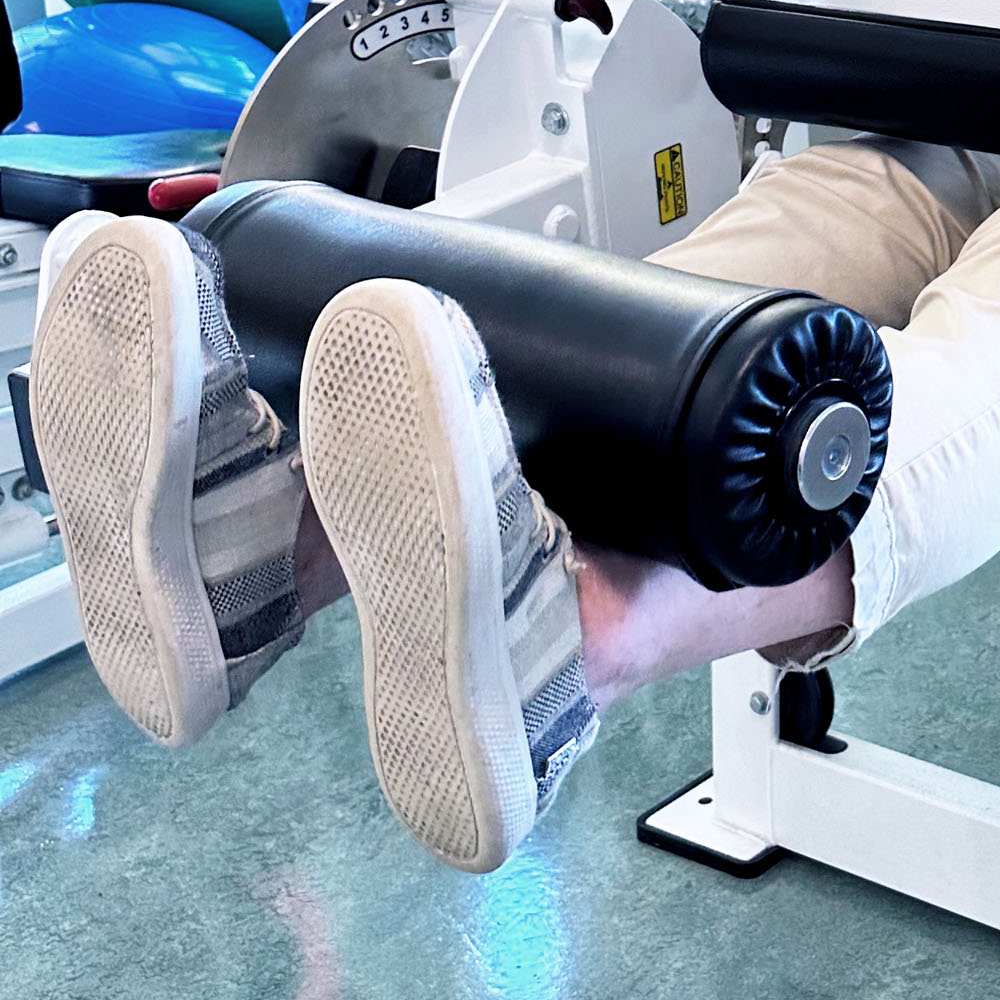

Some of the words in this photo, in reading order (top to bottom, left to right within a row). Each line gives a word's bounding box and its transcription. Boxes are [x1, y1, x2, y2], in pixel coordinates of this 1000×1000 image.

[360, 38, 369, 50] 1
[379, 25, 390, 39] 2
[400, 16, 409, 31] 3
[421, 10, 430, 25] 4
[441, 8, 450, 22] 5
[673, 161, 685, 216] CAUTION
